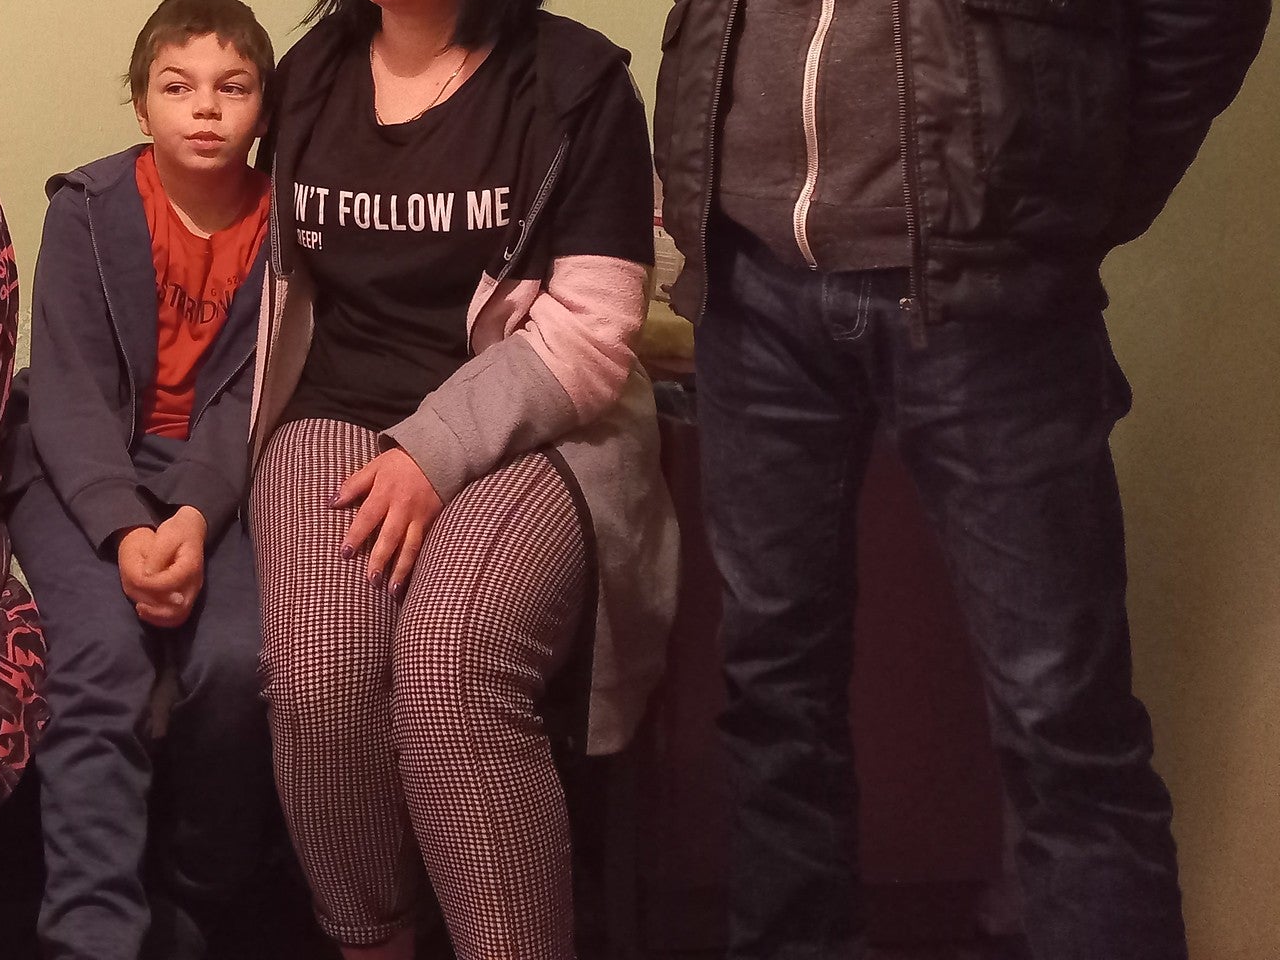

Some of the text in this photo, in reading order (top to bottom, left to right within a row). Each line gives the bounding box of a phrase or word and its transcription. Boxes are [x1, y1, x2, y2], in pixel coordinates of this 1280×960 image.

[293, 182, 510, 232] N'T FOLLOW ME
